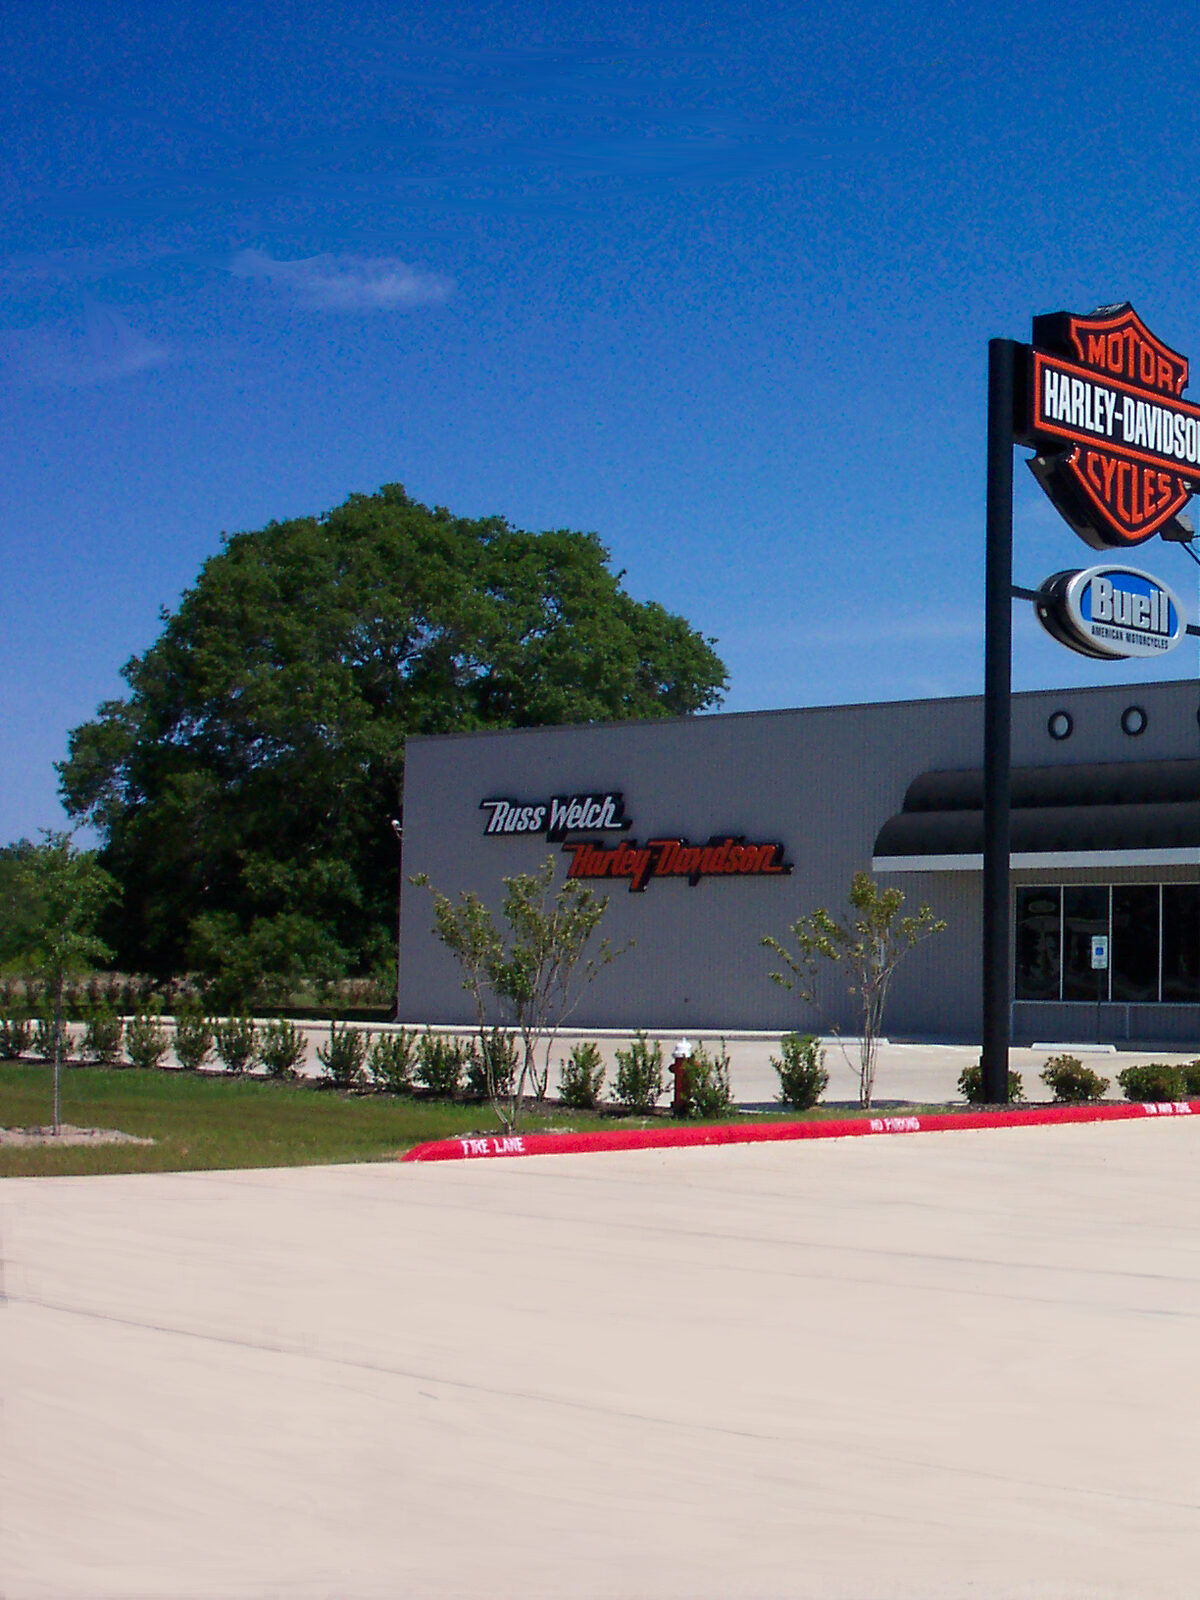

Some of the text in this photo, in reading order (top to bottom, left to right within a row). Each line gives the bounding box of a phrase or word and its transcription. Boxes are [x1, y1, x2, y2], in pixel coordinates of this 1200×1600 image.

[1088, 327, 1174, 392] MOTOR
[1087, 451, 1172, 525] CYCLES
[1090, 575, 1169, 634] Buell
[1091, 624, 1169, 650] AMERICAN MOTORCYCLES
[482, 796, 623, 832] Russ Welch
[562, 838, 786, 892] Harley-Davidson
[461, 1137, 526, 1155] FIRE LANE
